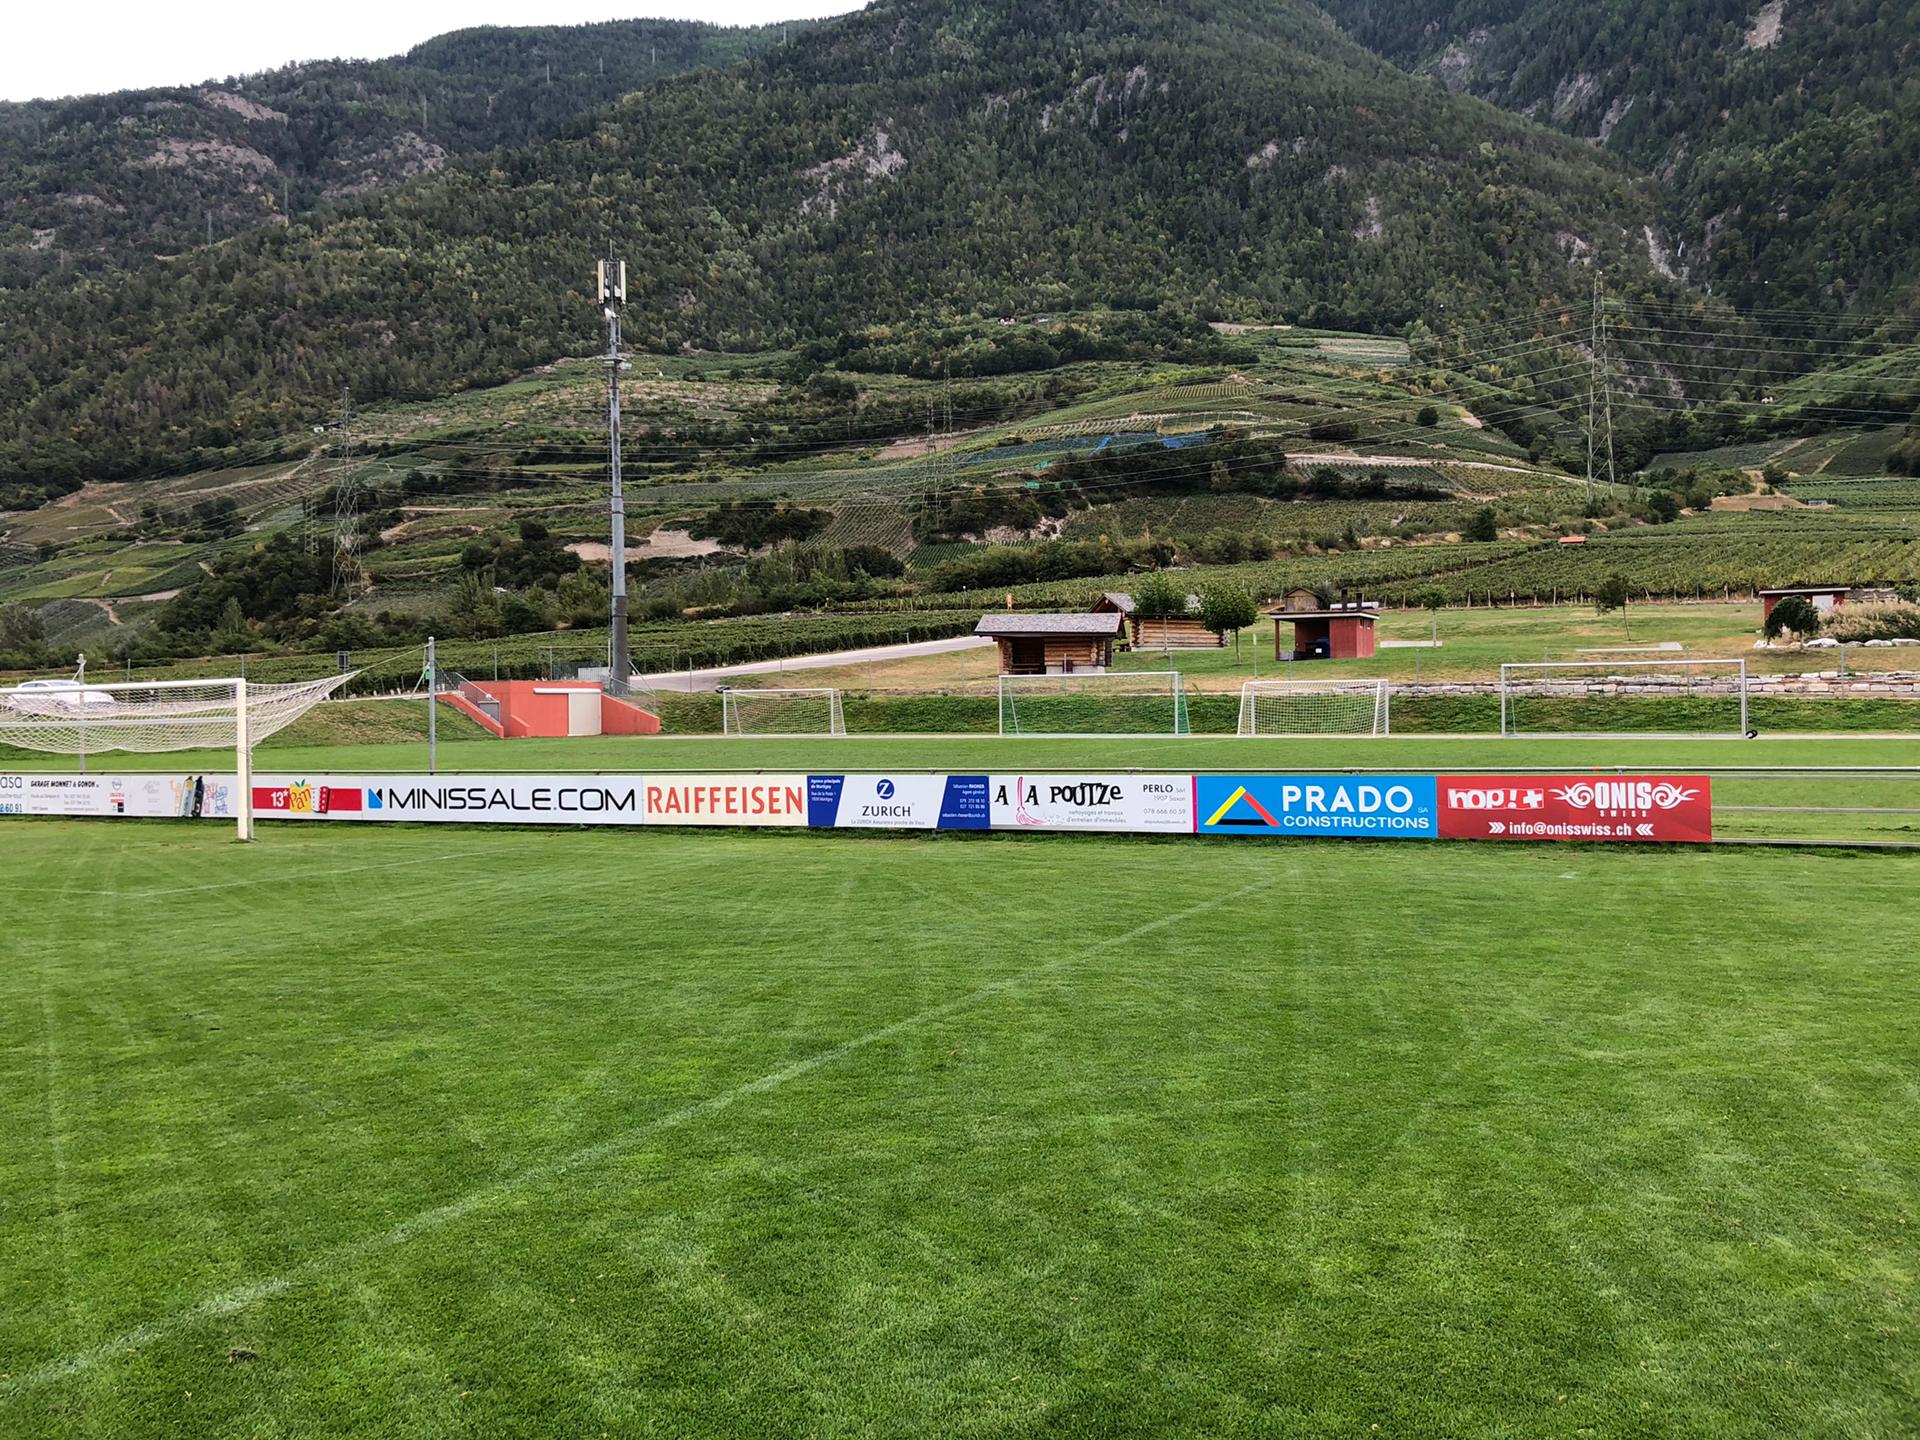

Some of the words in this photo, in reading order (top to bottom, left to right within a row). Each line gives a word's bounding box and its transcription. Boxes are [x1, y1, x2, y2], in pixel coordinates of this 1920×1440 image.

[30, 780, 50, 788] GARAGE
[51, 780, 72, 788] MONNET
[1143, 784, 1174, 793] PERLO
[290, 788, 311, 810] Pam
[389, 788, 635, 812] MINISSALE.COM
[647, 786, 803, 814] RAIFFEISEN
[1282, 785, 1414, 813] PRADO
[1418, 806, 1428, 814] SA
[1594, 782, 1652, 809] ONIS
[861, 805, 911, 817] ZURICH
[1283, 815, 1430, 829] CONSTRUCTIONS
[1509, 821, 1632, 837] info@onisswiss.ch
